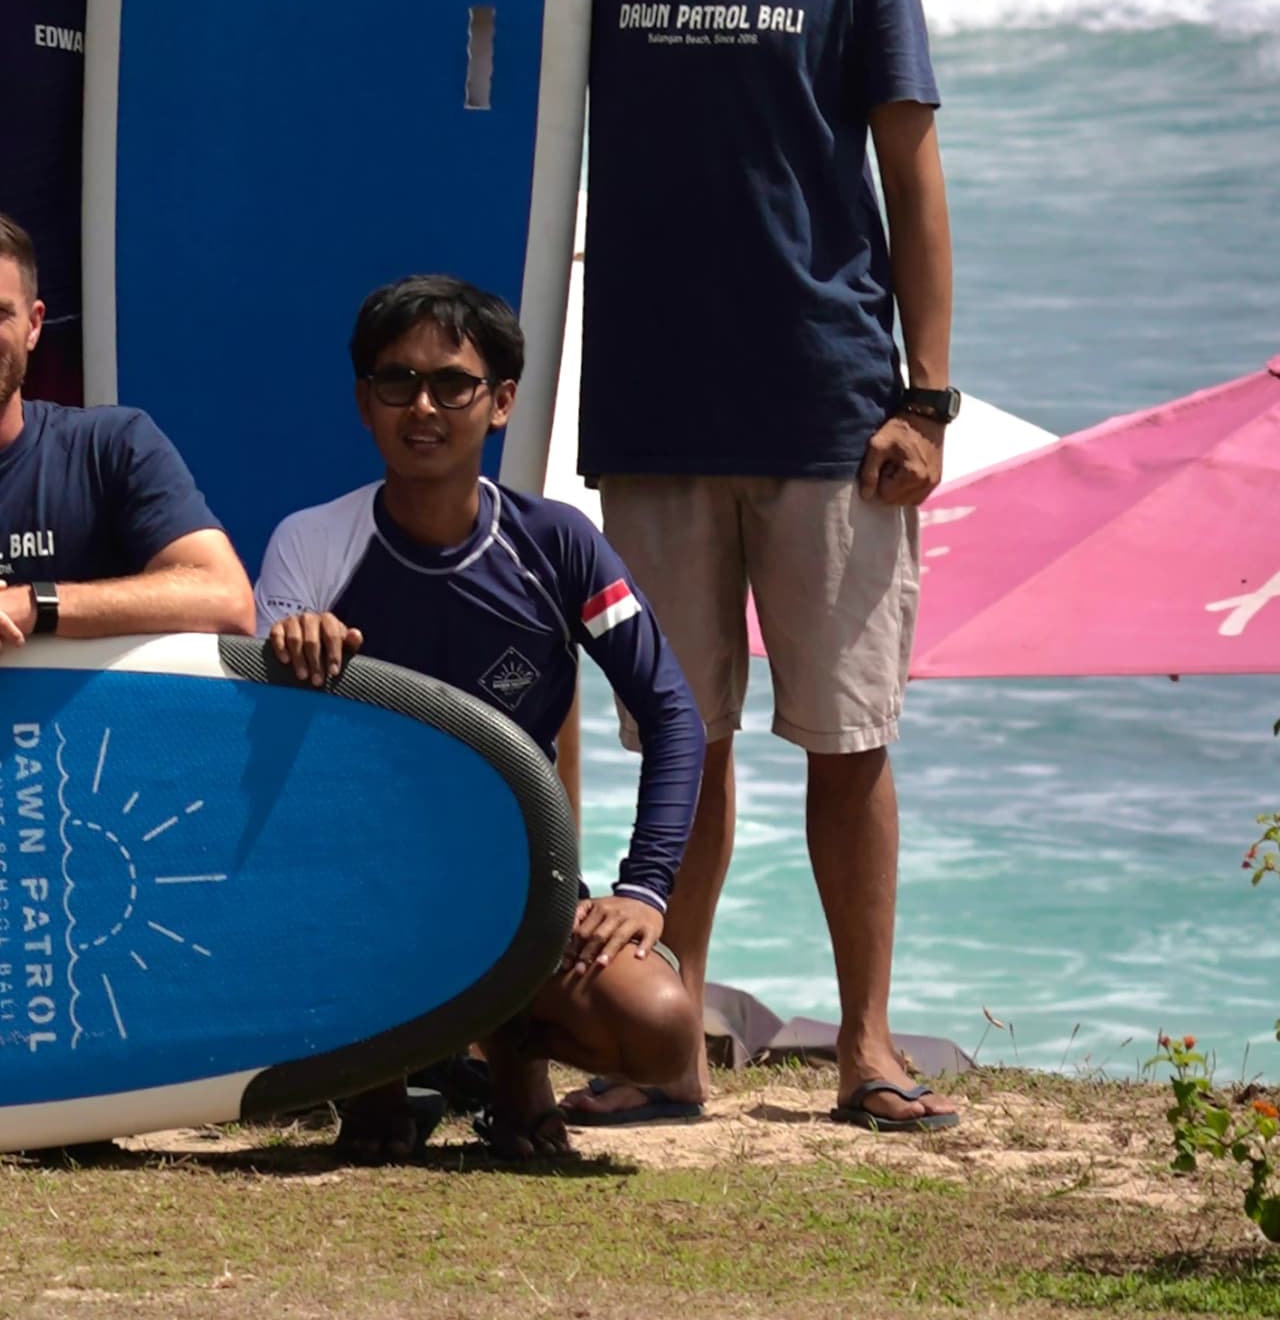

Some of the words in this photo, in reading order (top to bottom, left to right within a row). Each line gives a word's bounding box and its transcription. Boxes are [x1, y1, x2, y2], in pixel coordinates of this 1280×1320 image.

[618, 2, 671, 29] DAWN
[676, 4, 750, 30] PATROL
[757, 4, 805, 34] BALI
[9, 530, 55, 559] BALI
[13, 723, 46, 853] DAWN
[20, 878, 56, 1052] PATROL
